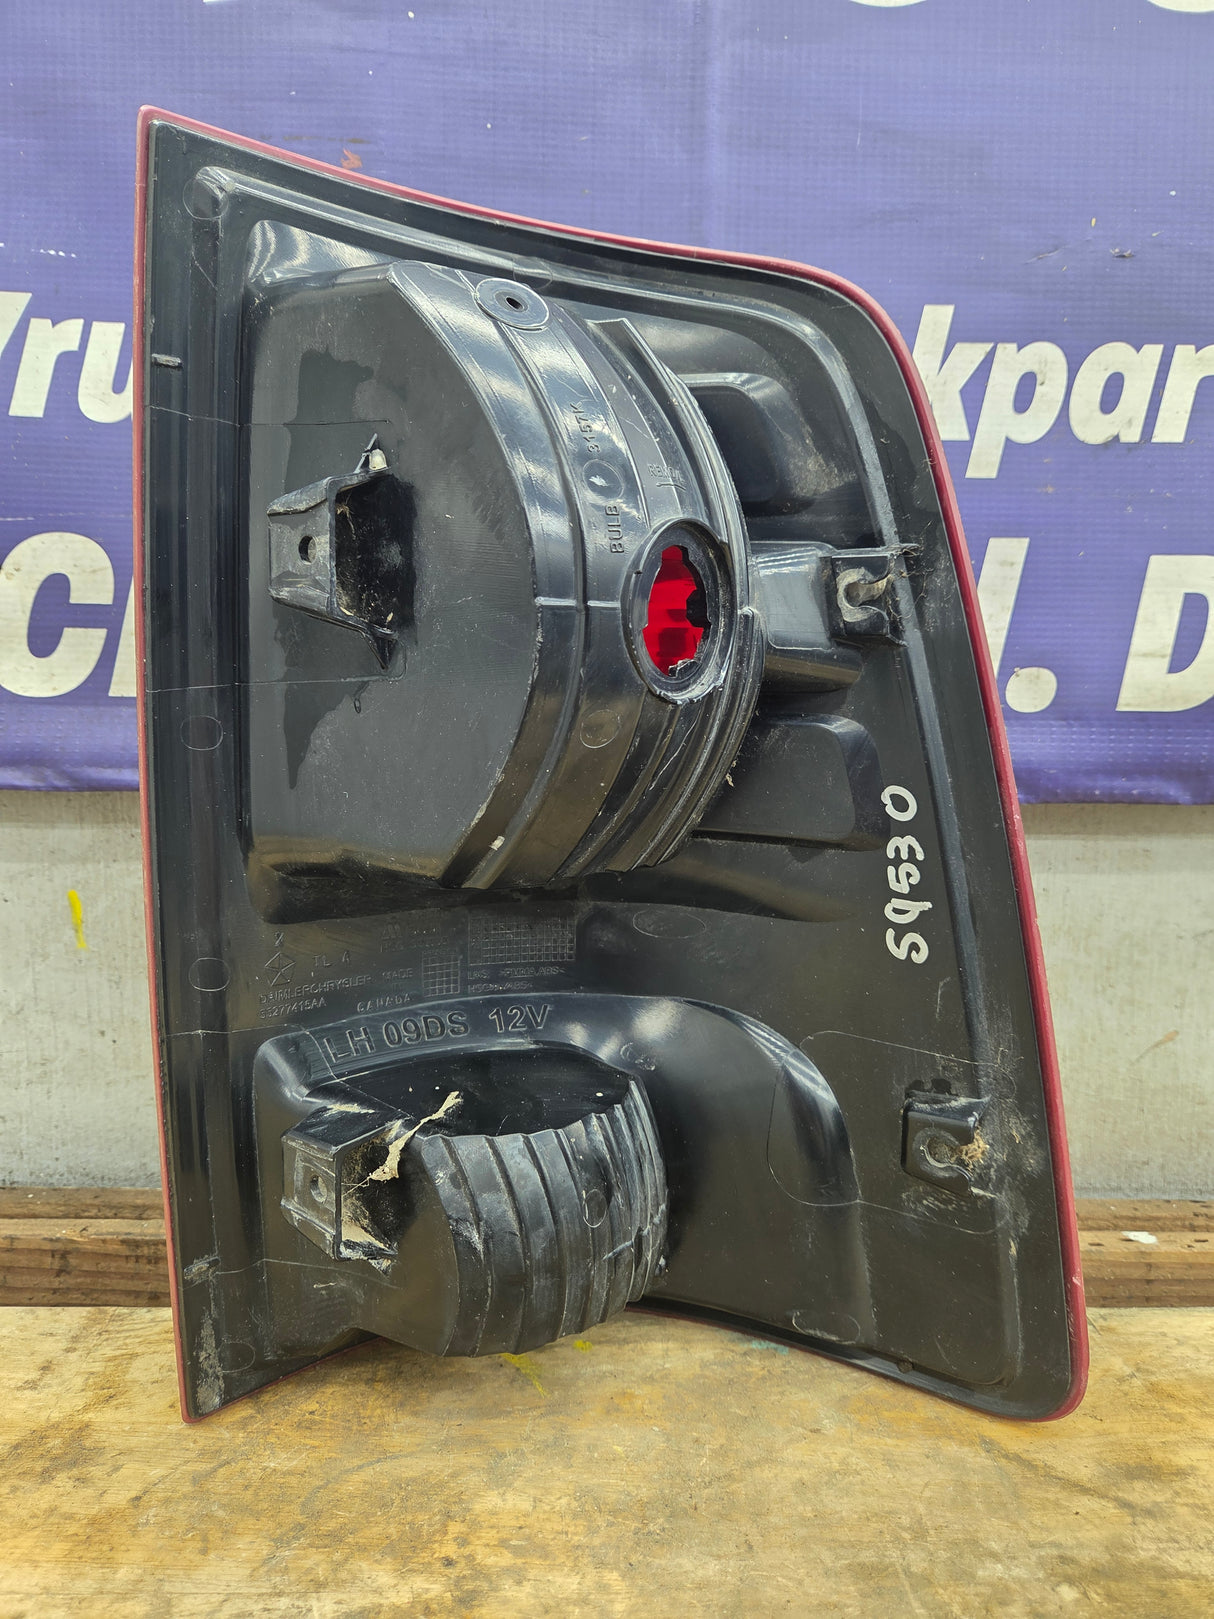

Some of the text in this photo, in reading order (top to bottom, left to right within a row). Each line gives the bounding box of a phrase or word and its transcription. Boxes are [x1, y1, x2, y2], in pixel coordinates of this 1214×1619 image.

[570, 402, 625, 554] BULB 3157K
[323, 1003, 553, 1064] LH 09DS 12V
[357, 993, 414, 1015] CANADA
